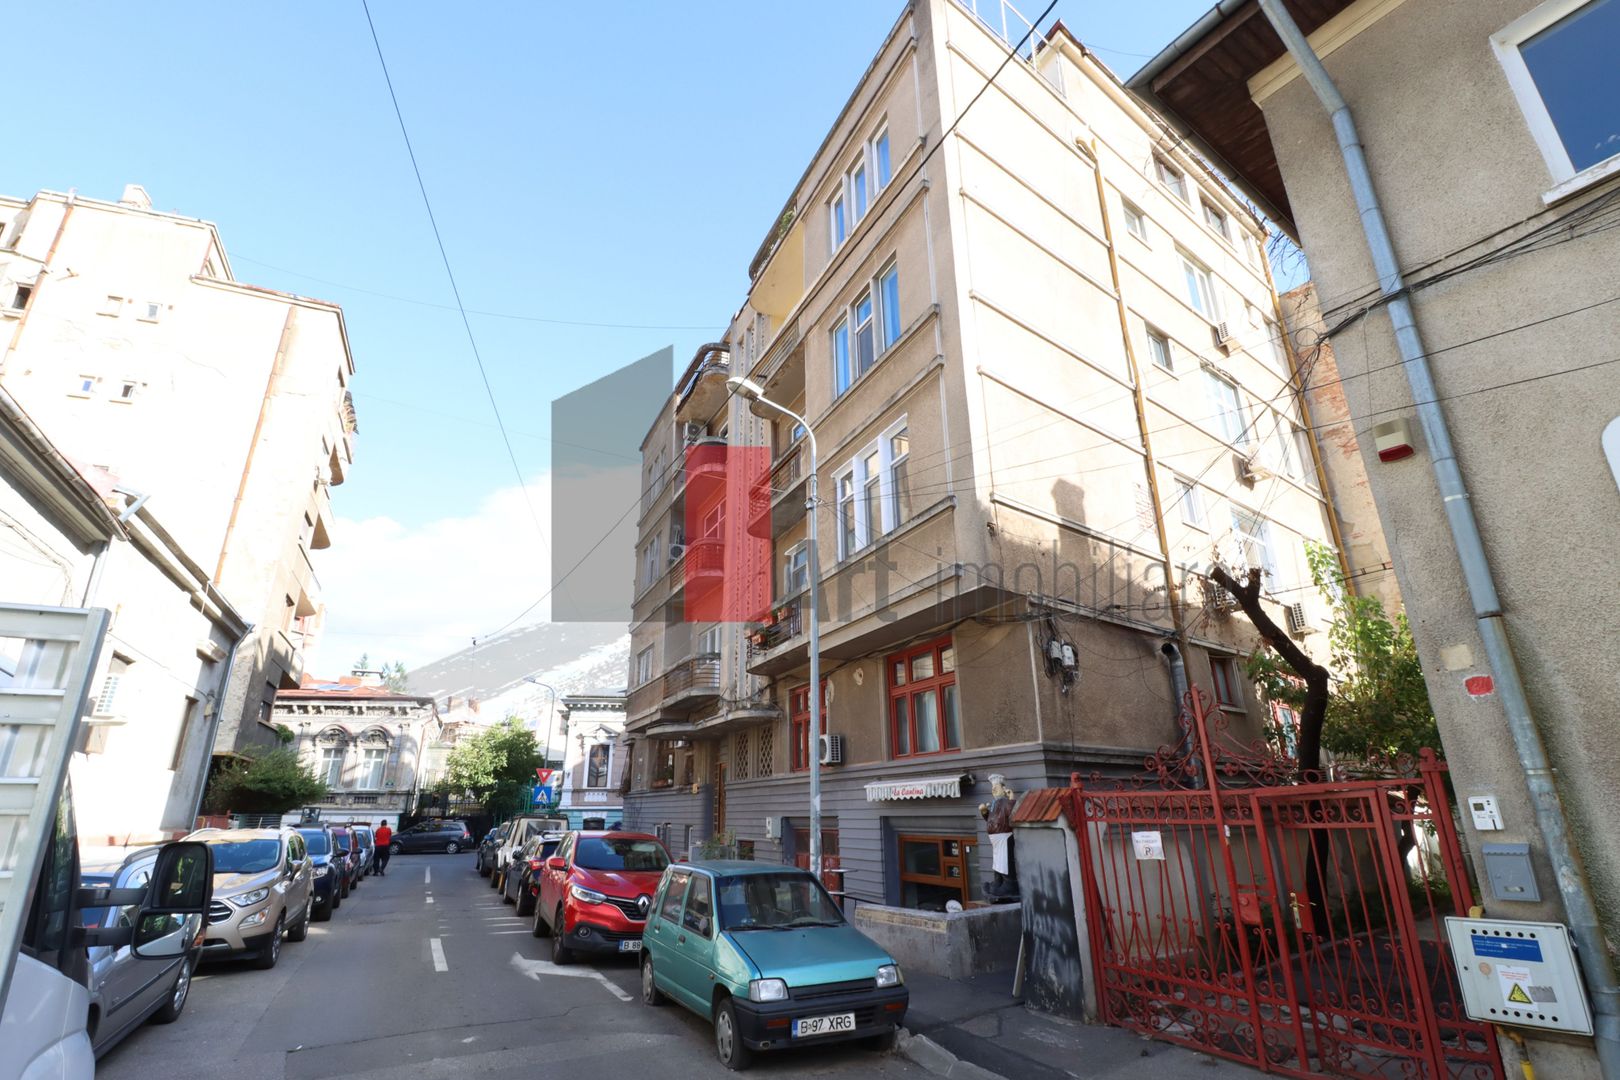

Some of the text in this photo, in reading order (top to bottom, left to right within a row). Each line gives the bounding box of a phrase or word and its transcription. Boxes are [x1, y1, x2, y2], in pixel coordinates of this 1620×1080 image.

[624, 941, 629, 949] B
[801, 1016, 851, 1034] B 97 XRG
